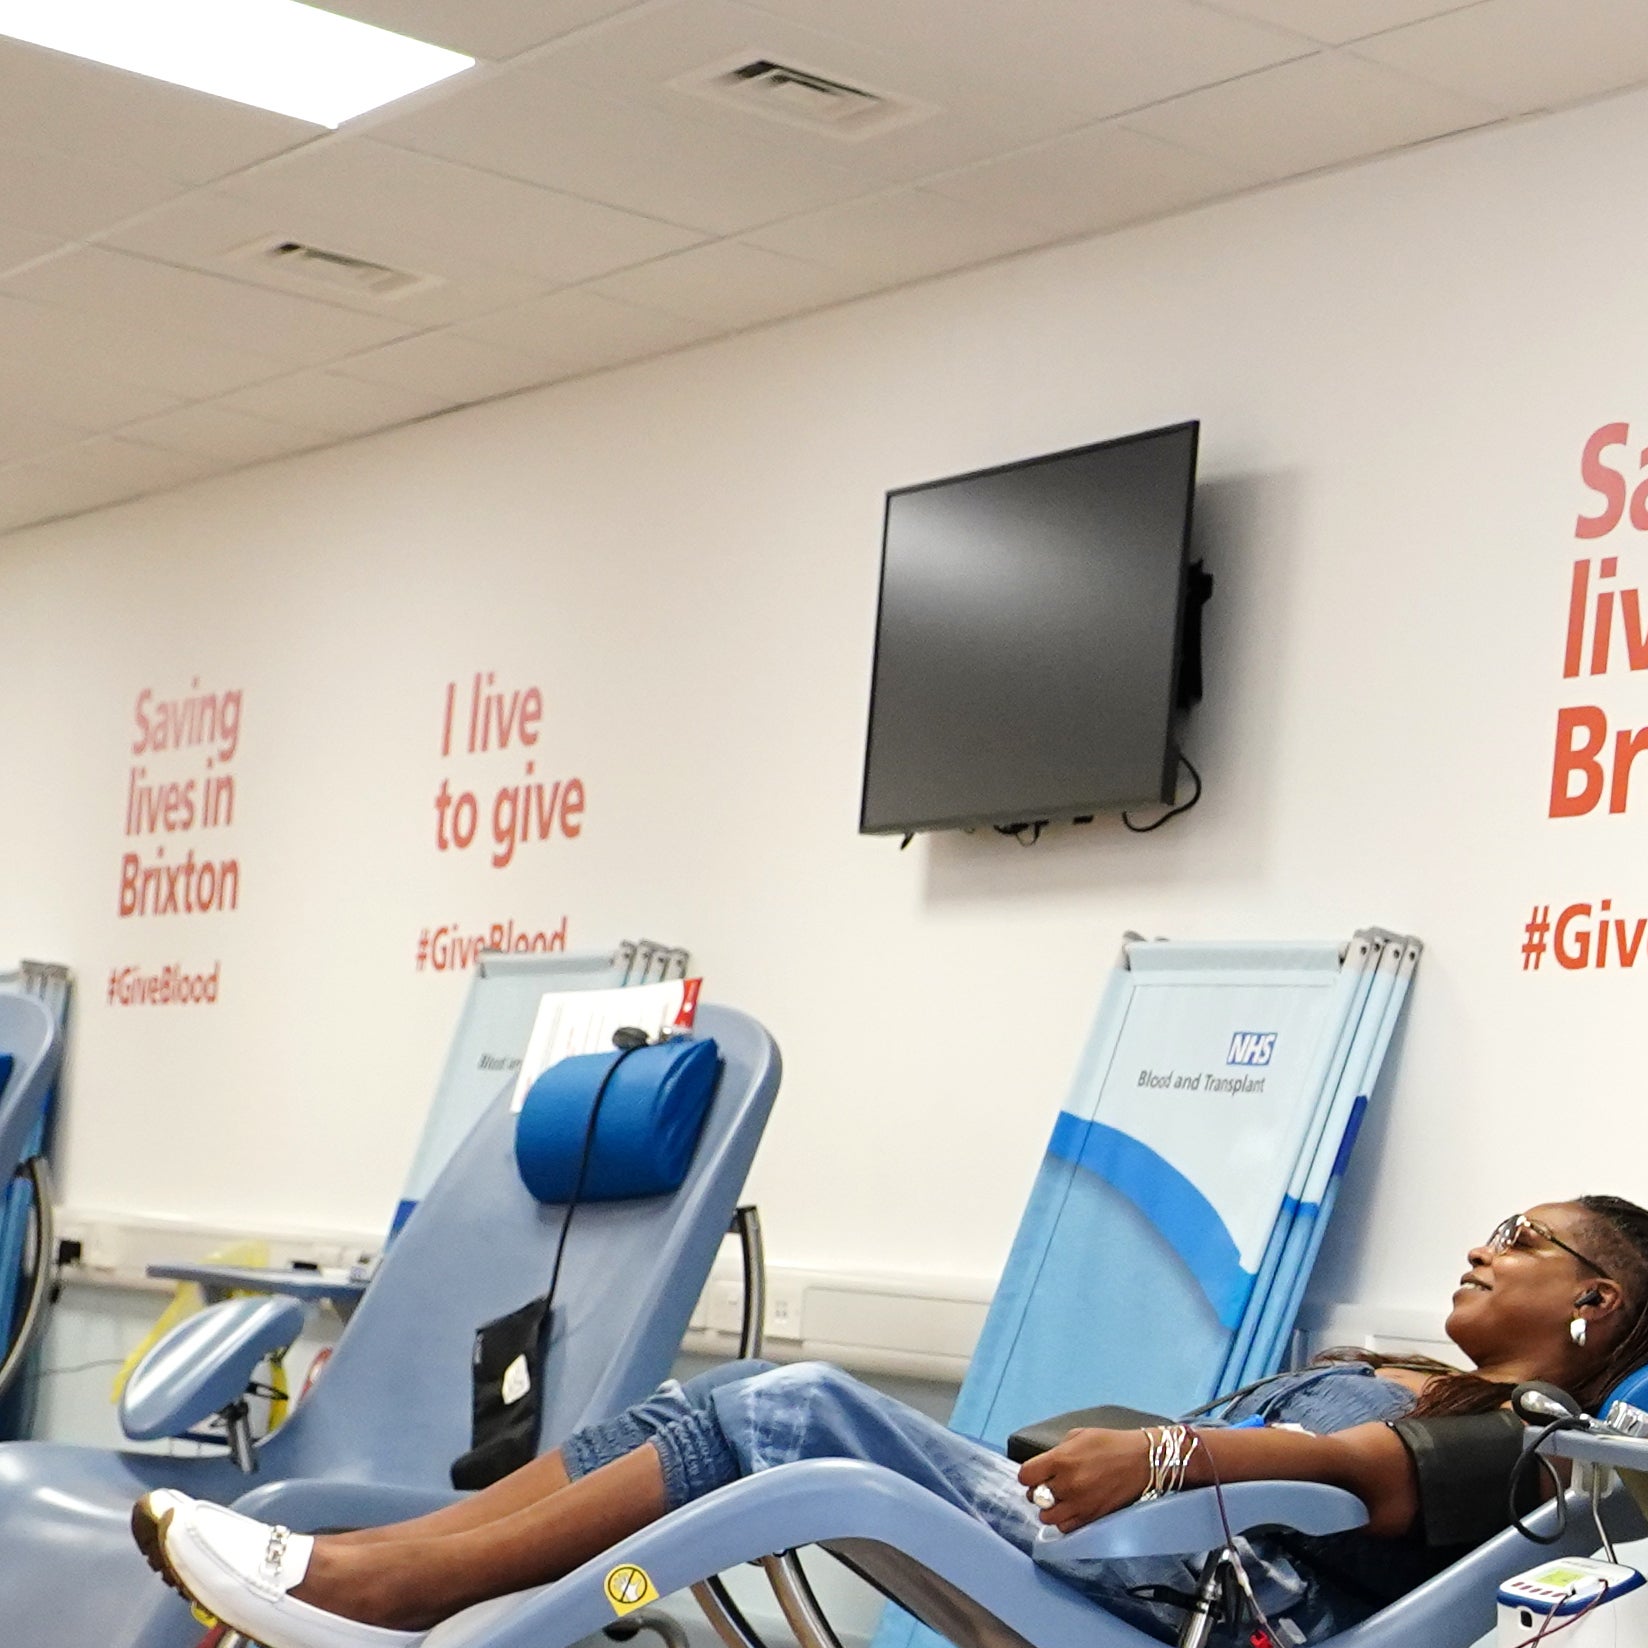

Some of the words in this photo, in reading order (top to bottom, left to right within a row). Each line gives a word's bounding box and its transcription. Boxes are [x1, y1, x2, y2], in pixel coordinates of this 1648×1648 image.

[131, 676, 243, 761] Saving
[440, 682, 457, 757] I
[467, 672, 543, 754] live
[125, 767, 195, 837] lives
[202, 757, 235, 829] in
[434, 778, 478, 852] to
[491, 762, 586, 870] give
[119, 847, 240, 918] Brixton
[107, 962, 221, 1006] #GiveBlood
[1137, 1069, 1174, 1089] Blood
[1174, 1073, 1202, 1091] and
[1204, 1074, 1266, 1096] Transplant
[1228, 1032, 1277, 1065] NHS
